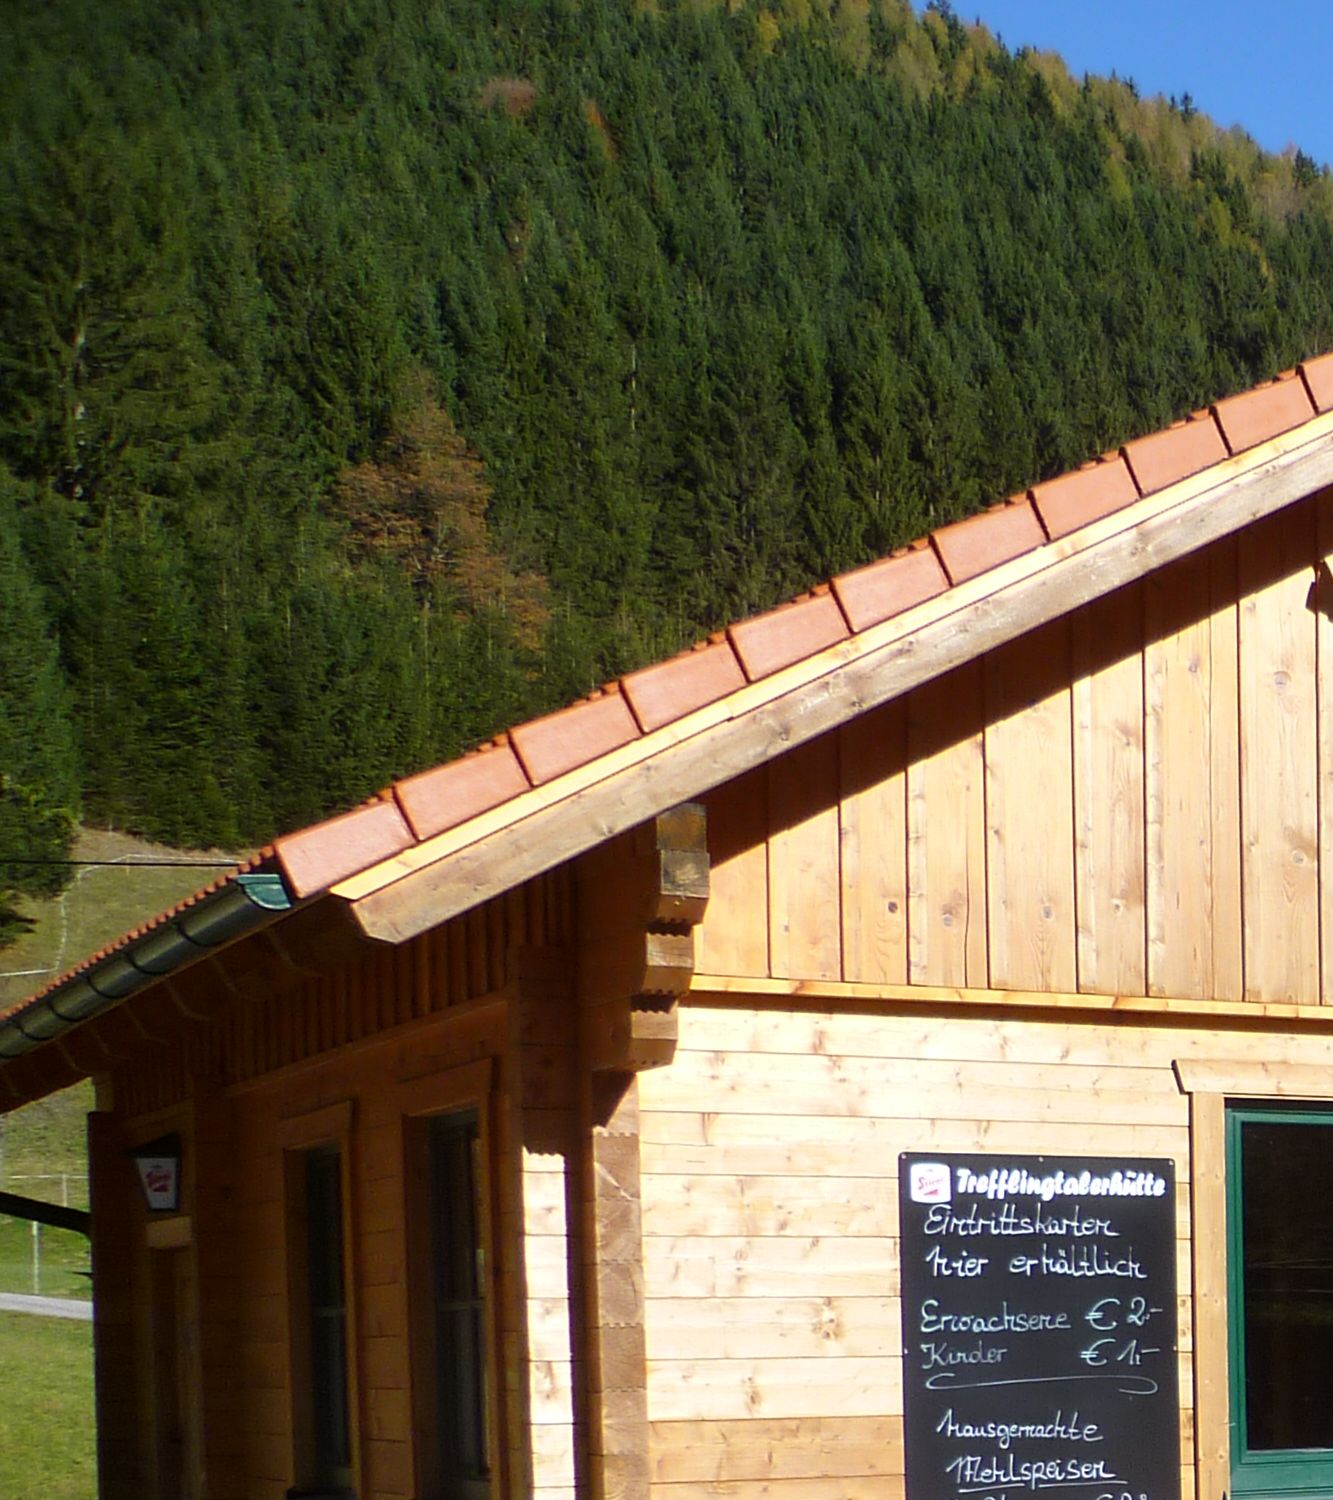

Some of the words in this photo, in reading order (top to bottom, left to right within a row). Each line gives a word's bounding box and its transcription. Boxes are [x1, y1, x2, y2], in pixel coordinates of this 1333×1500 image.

[957, 1168, 1165, 1201] Trefflingtalerhütte
[924, 1202, 1120, 1237] Eintrittskarten
[926, 1245, 989, 1277] hier
[1009, 1243, 1148, 1278] erhältlich
[920, 1300, 1071, 1332] Erwachsene
[1085, 1298, 1120, 1330] €
[921, 1341, 1007, 1369] Kinder
[1081, 1339, 1116, 1366] €
[946, 1454, 1116, 1490] Mehlspeisen
